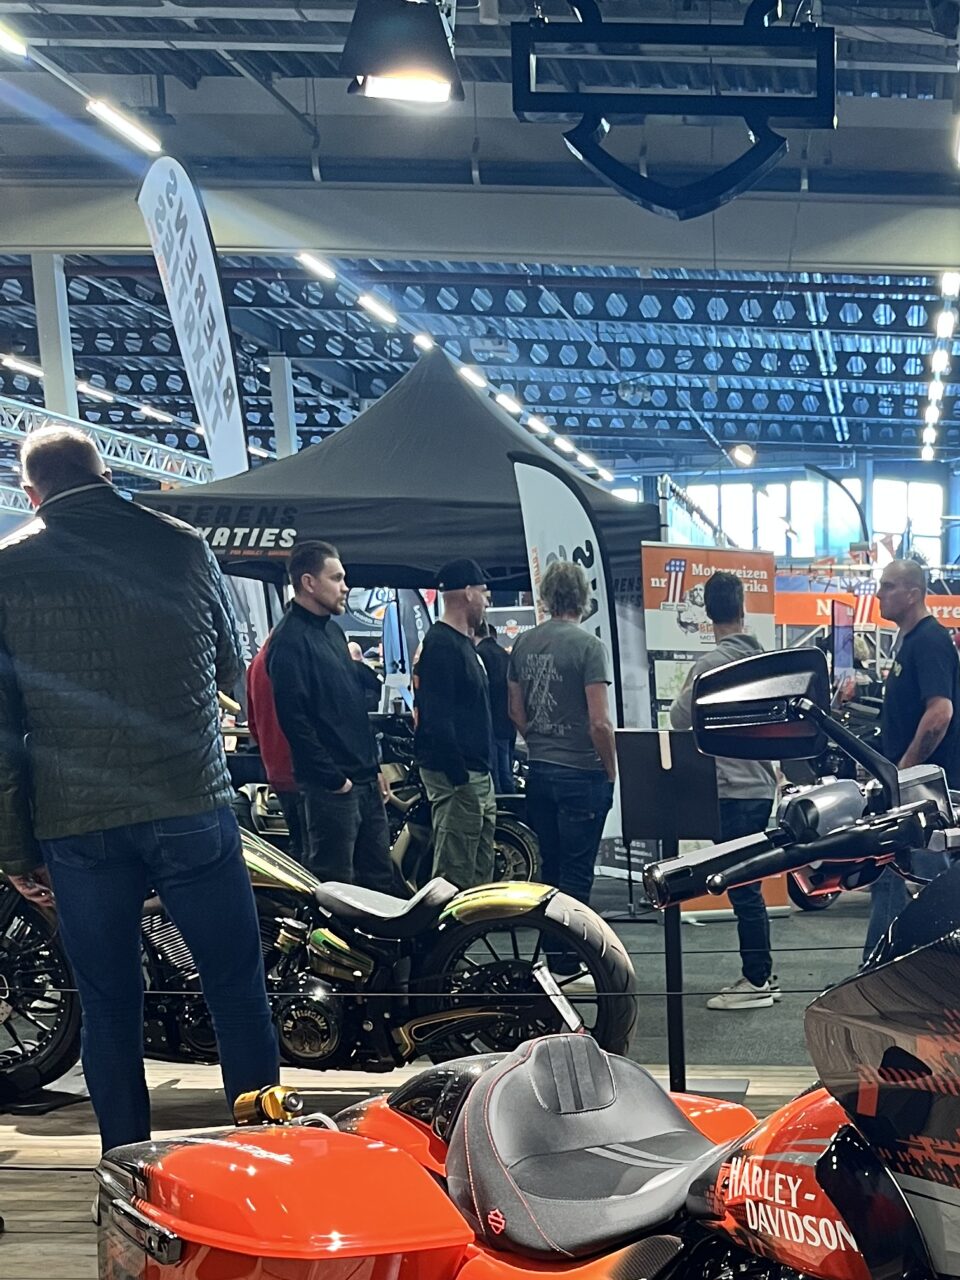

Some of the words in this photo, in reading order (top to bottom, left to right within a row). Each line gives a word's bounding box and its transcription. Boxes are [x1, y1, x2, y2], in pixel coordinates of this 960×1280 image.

[157, 502, 299, 526] EERENS
[196, 526, 299, 549] XATIES
[744, 580, 769, 593] rika
[728, 1156, 817, 1209] HARLEY-
[745, 1197, 860, 1254] DAVIDSON
